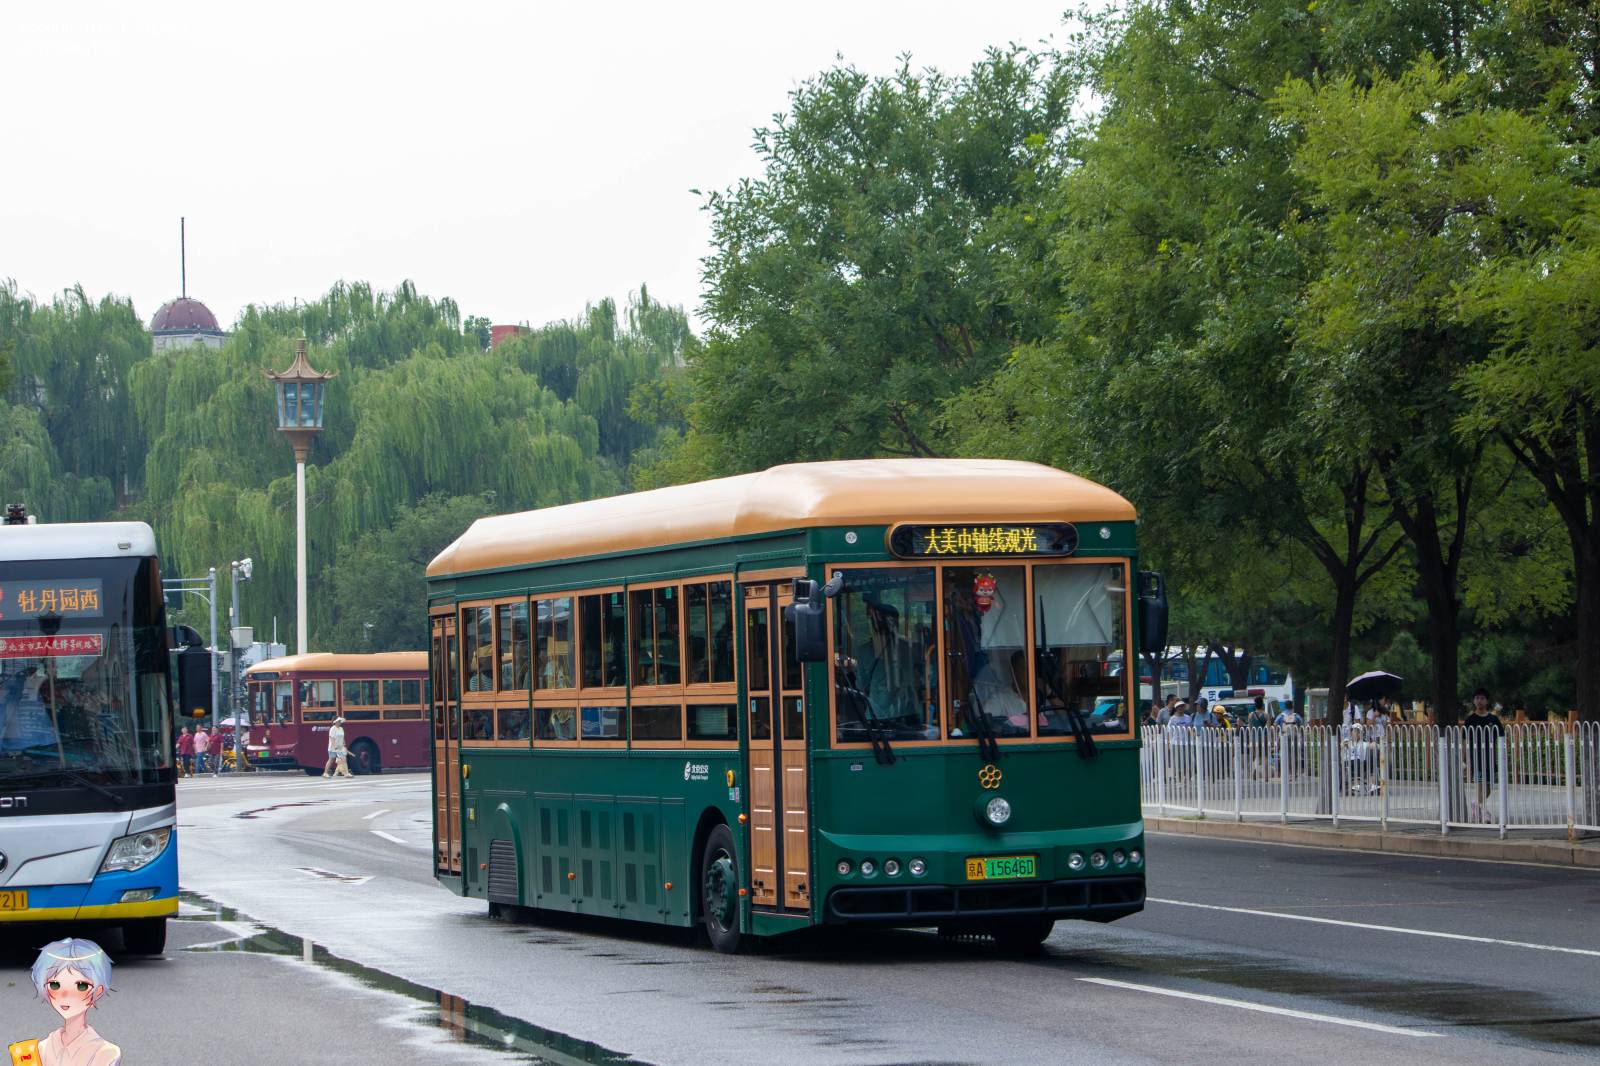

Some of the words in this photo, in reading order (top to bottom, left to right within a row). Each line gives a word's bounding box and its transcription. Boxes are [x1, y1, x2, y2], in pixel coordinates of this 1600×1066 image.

[924, 527, 1037, 554] 大美中轴线观光
[17, 588, 99, 613] 牡丹园西
[0, 892, 25, 908] 211
